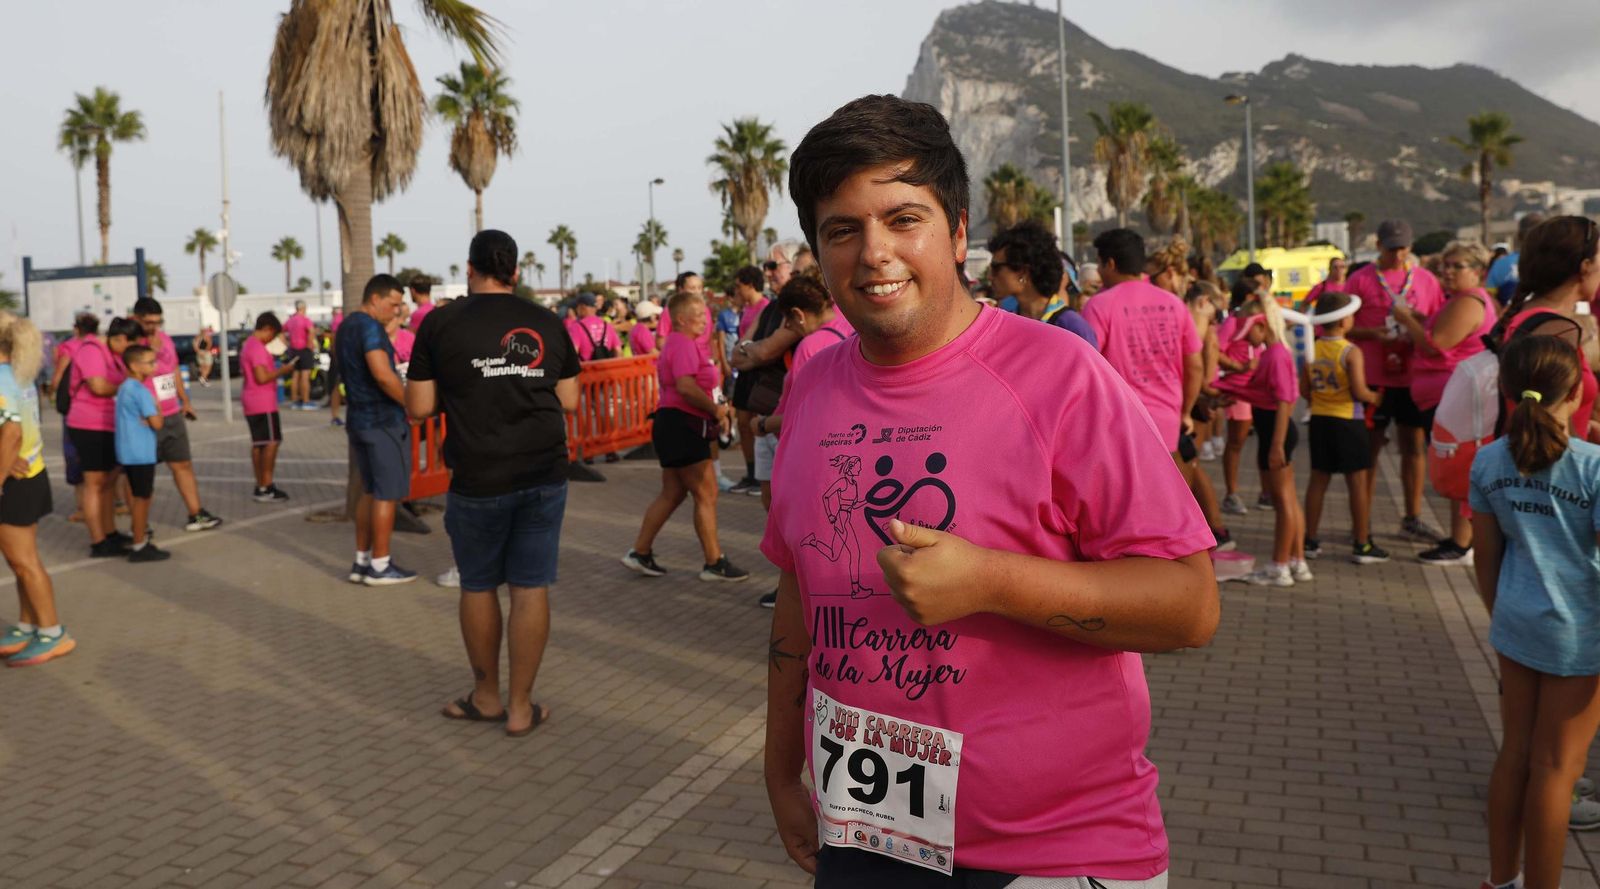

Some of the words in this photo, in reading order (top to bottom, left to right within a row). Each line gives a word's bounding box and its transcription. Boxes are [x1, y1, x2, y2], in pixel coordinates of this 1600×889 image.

[481, 363, 528, 378] Running
[1312, 368, 1340, 390] 24
[898, 424, 942, 435] Diputación
[819, 438, 852, 448] Algeciras
[1503, 477, 1520, 488] DE
[844, 617, 958, 651] Carrera
[816, 652, 833, 681] de
[837, 653, 863, 684] la
[868, 653, 967, 701] Mujer
[829, 718, 857, 742] POR
[863, 728, 884, 748] LA
[890, 737, 952, 766] MUJER
[866, 715, 946, 749] CARRERA
[820, 735, 925, 819] 791
[876, 812, 895, 821] RUBEN
